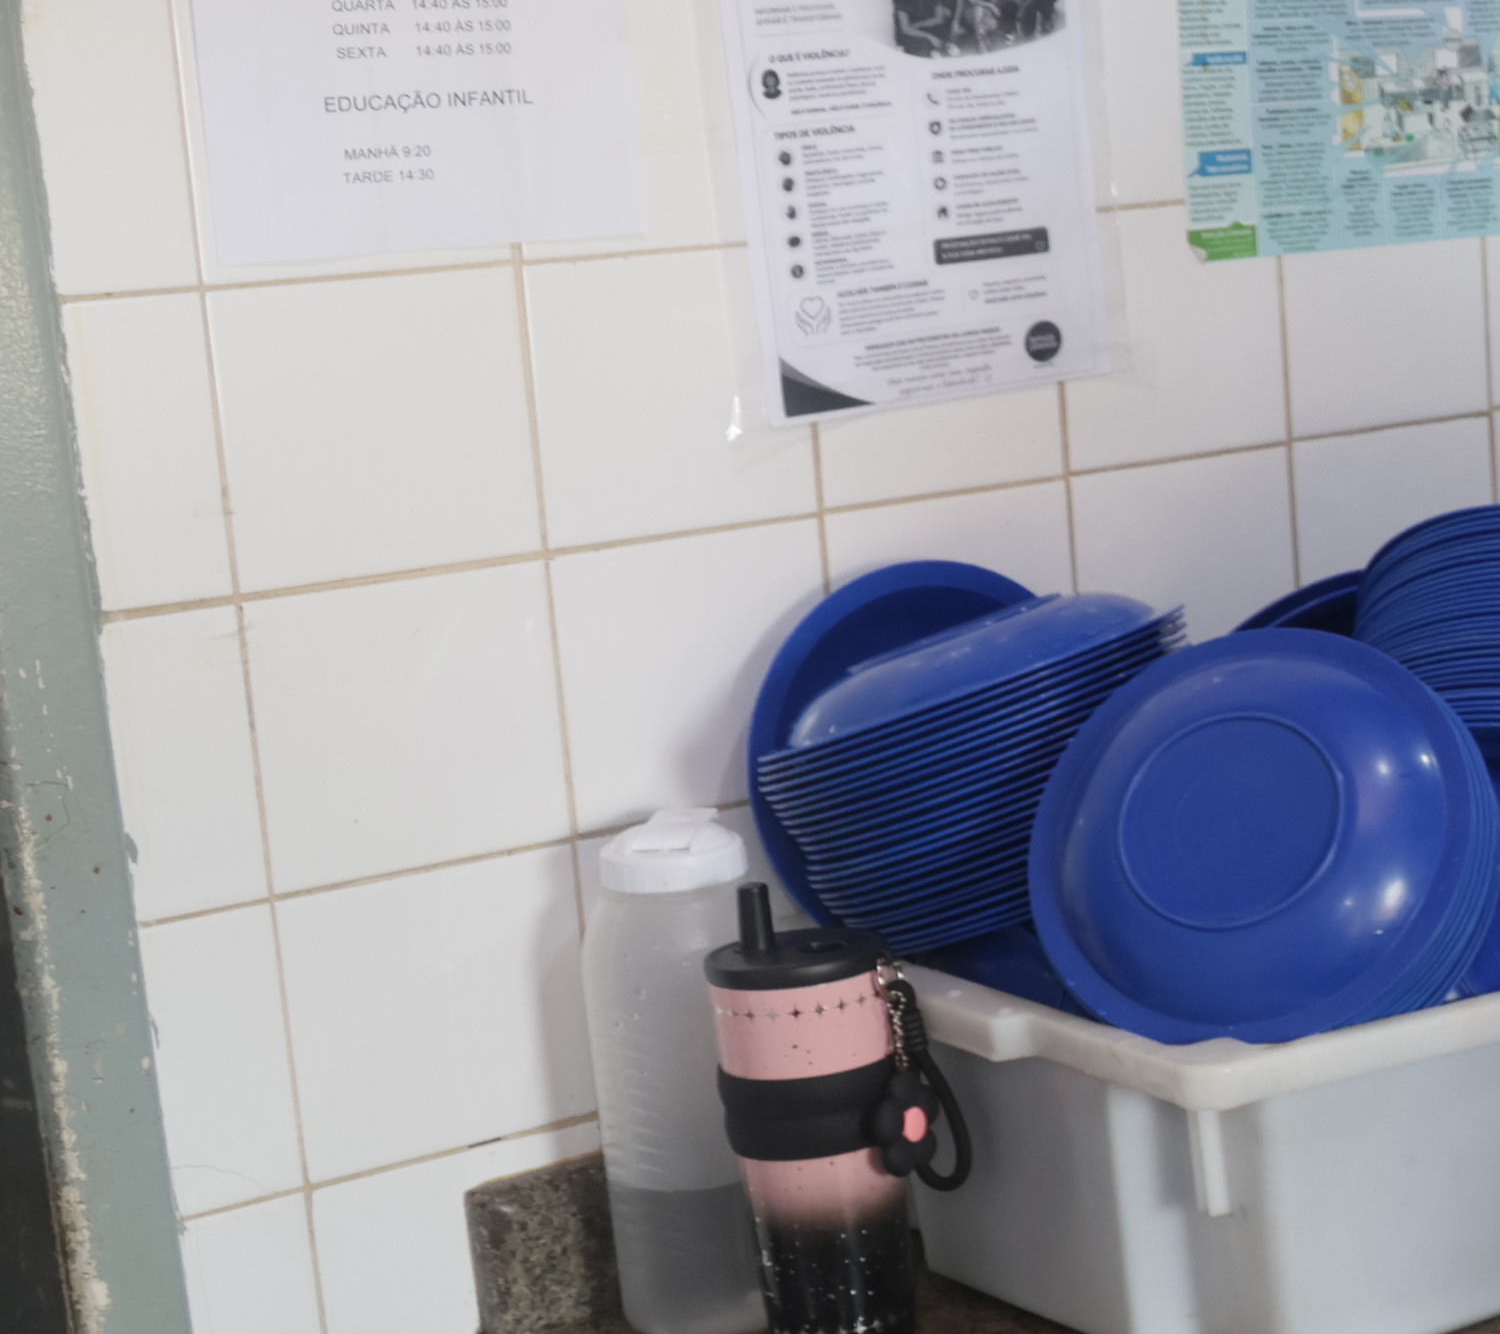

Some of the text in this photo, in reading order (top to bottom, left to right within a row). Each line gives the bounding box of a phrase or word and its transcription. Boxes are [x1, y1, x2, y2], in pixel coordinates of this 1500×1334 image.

[331, 0, 395, 12] QUARTA
[332, 18, 511, 36] QUINTA 14:40 ÀS 15:00
[336, 41, 512, 59] SEXTA 14:40 ÀS 15:00
[324, 89, 533, 113] EDUCAÇÃO INFANTIL
[343, 144, 431, 161] MANHÃ 9:20
[342, 168, 435, 184] TARDE 14:30
